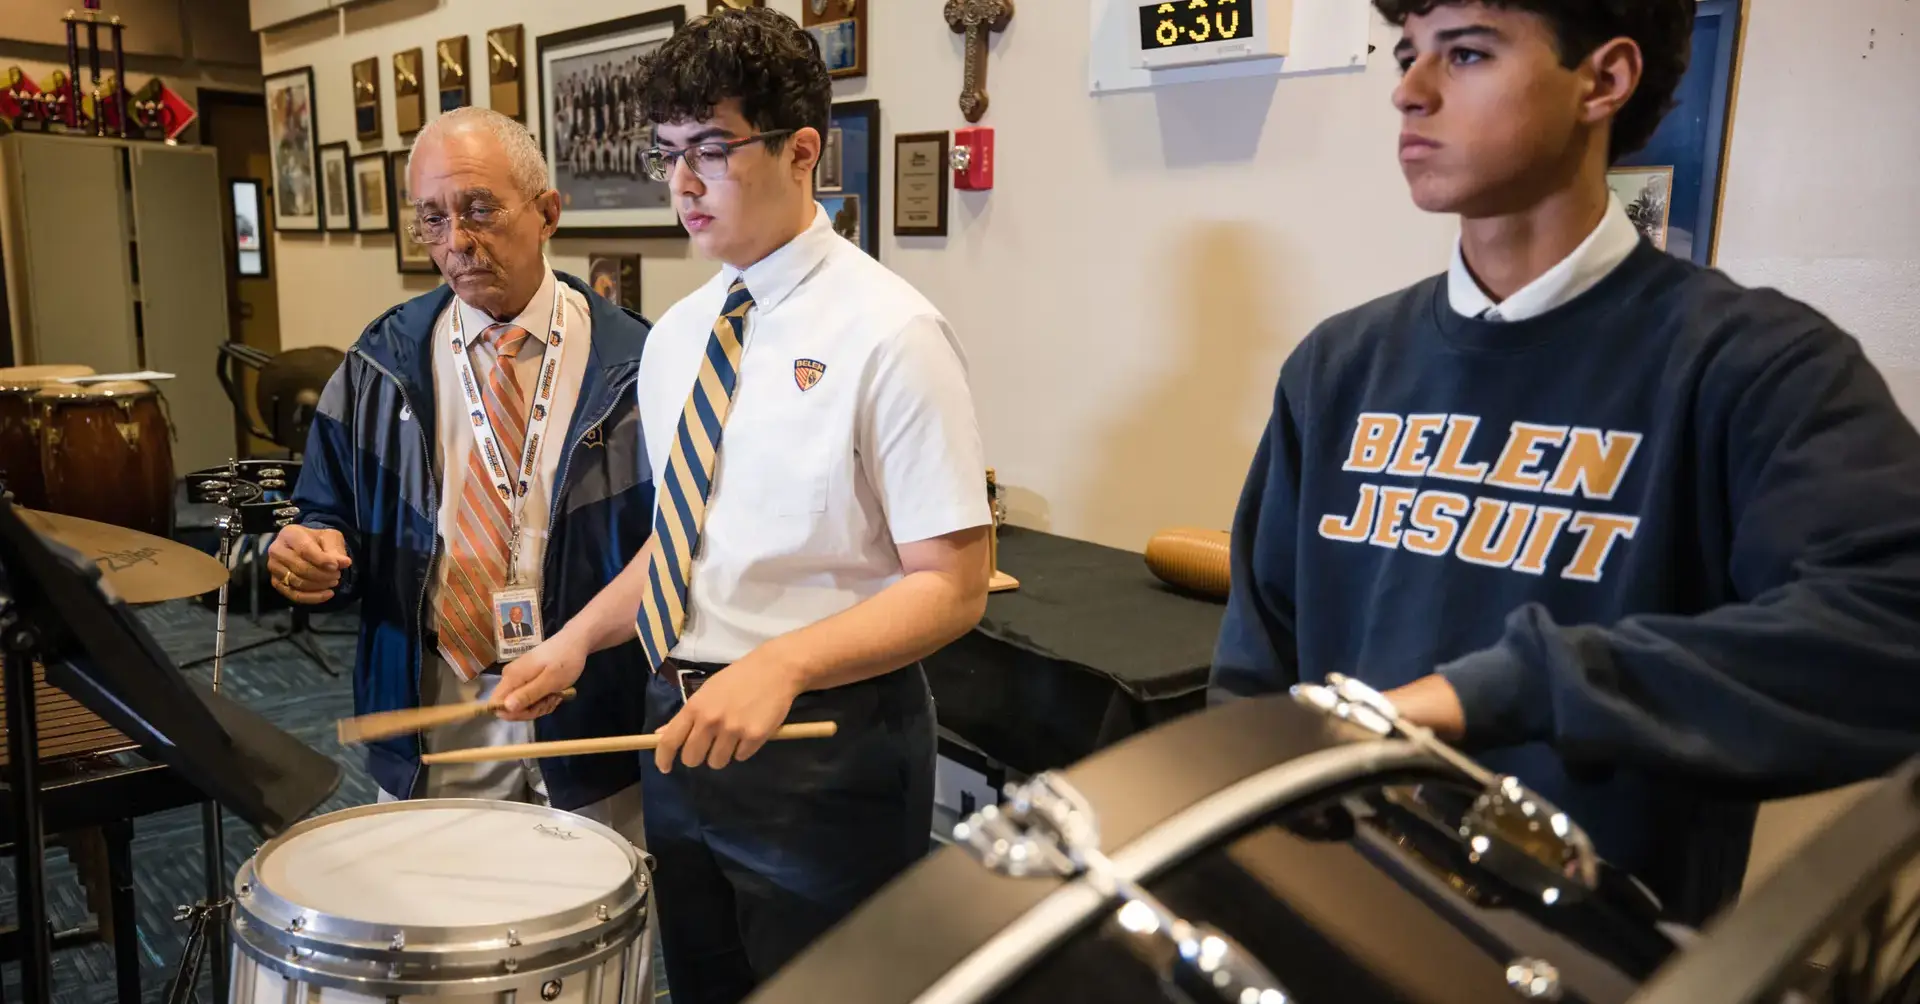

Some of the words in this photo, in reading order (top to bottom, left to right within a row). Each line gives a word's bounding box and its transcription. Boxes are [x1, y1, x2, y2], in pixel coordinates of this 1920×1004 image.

[796, 360, 823, 371] BELEN
[1342, 413, 1643, 500] BELEN
[1318, 483, 1640, 582] JESUIT
